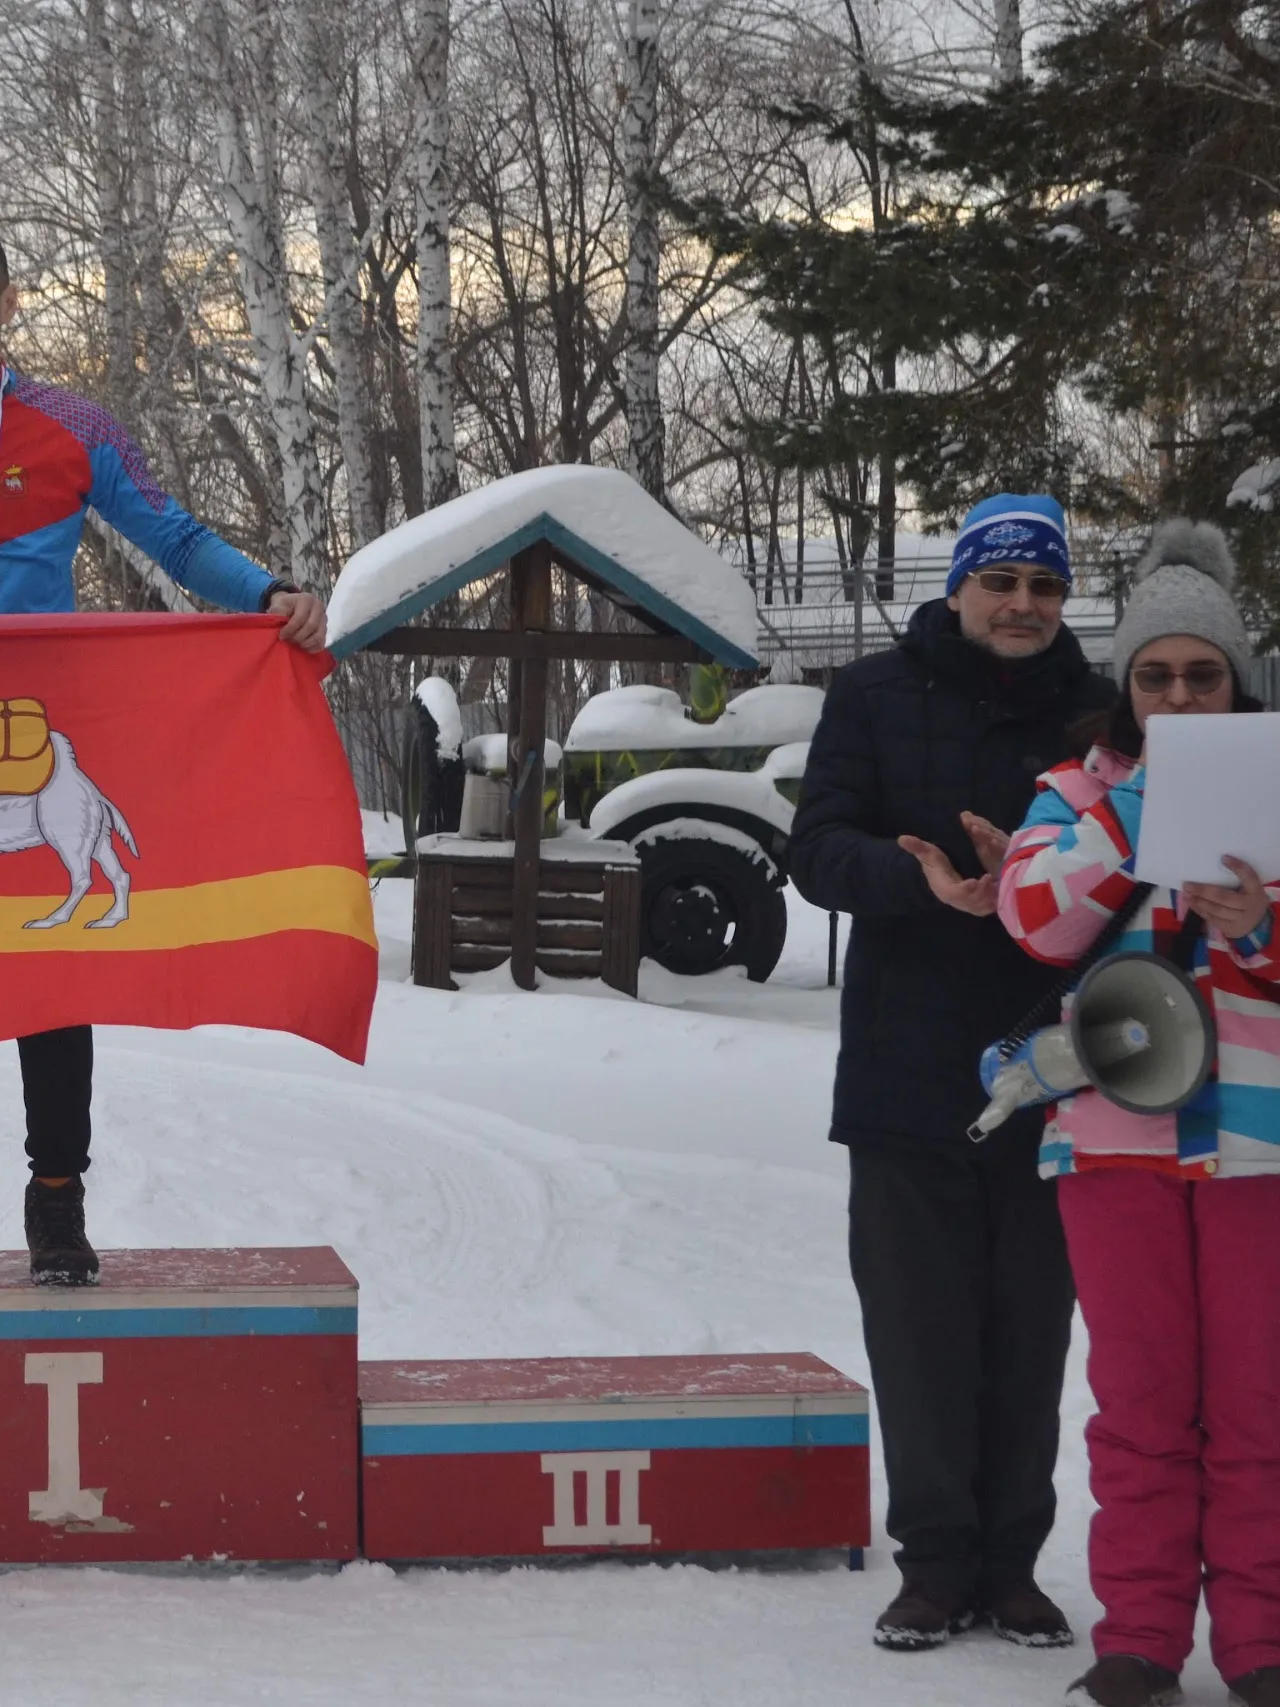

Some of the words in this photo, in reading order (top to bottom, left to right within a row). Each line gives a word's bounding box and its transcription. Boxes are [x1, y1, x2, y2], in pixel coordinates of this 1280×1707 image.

[976, 549, 1038, 564] 2014
[24, 1352, 108, 1524] I
[540, 1450, 652, 1546] III
